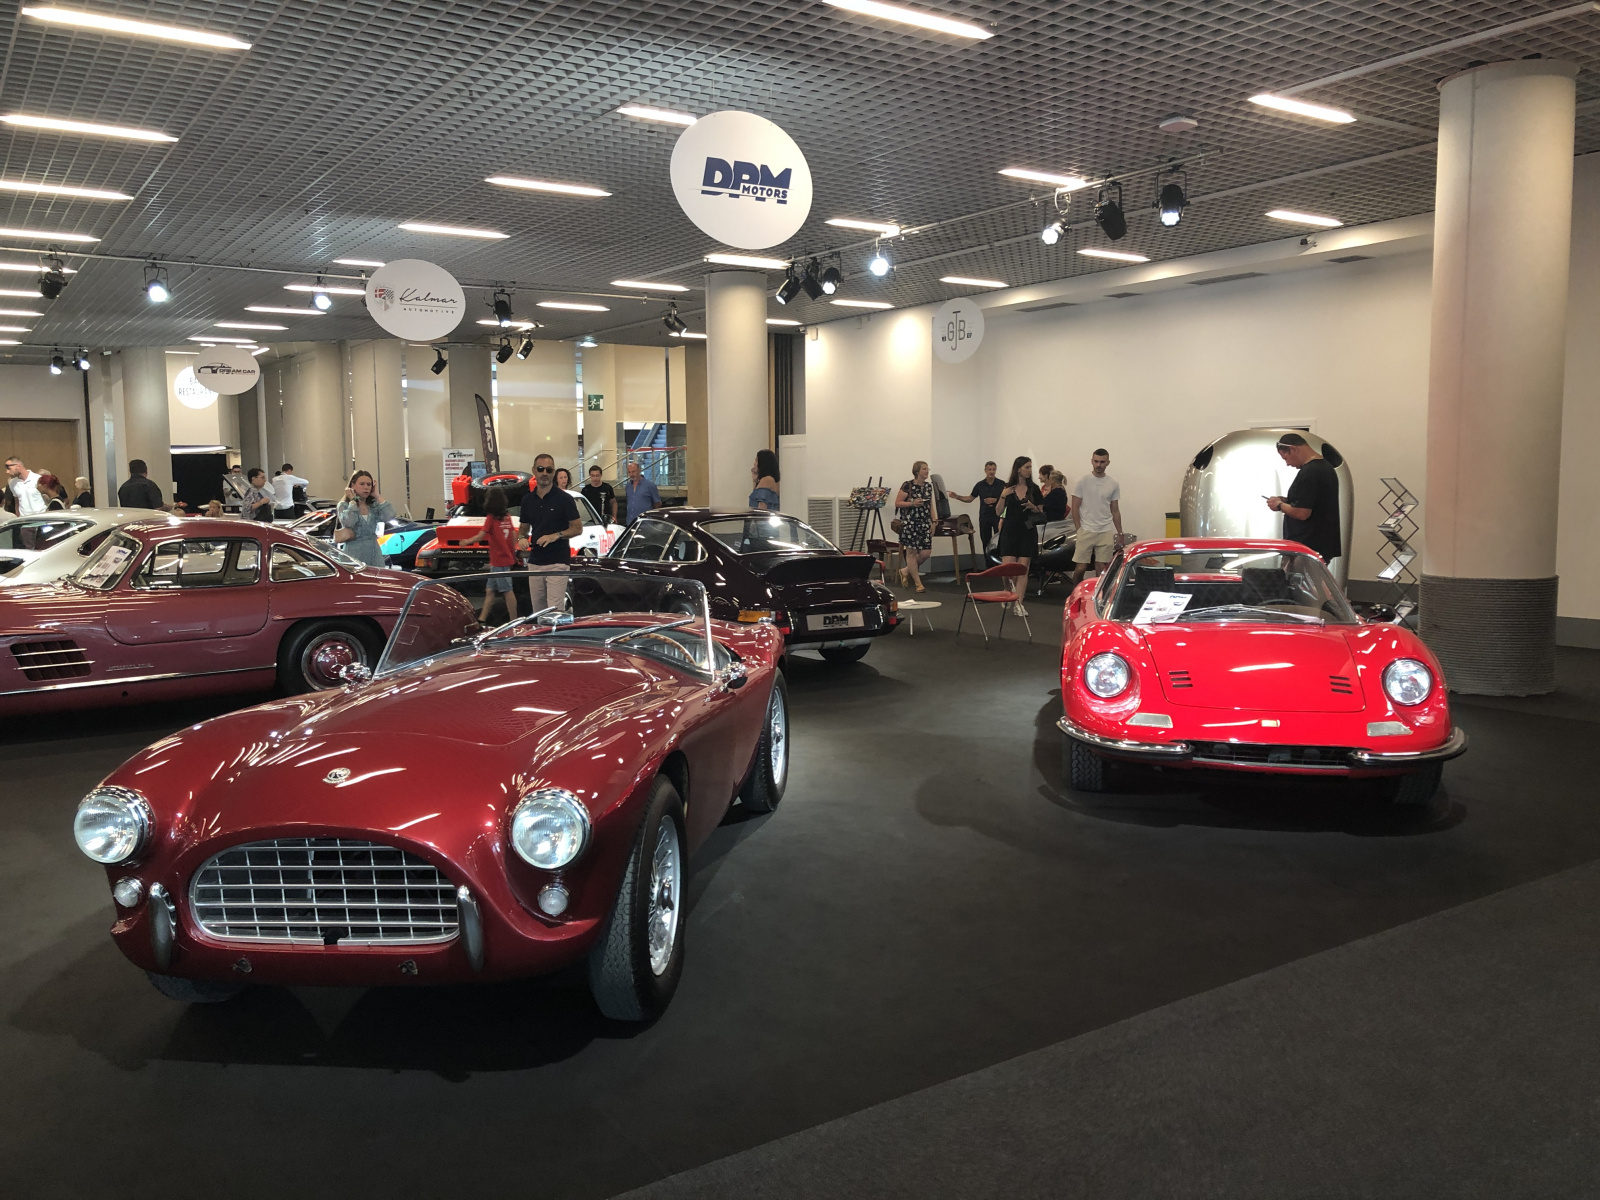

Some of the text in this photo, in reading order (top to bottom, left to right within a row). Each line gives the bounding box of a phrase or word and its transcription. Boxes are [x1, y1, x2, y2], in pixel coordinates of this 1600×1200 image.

[701, 157, 793, 205] DPM
[741, 184, 788, 199] MOTORS
[399, 288, 457, 304] Kalmar
[823, 614, 849, 627] DPM
